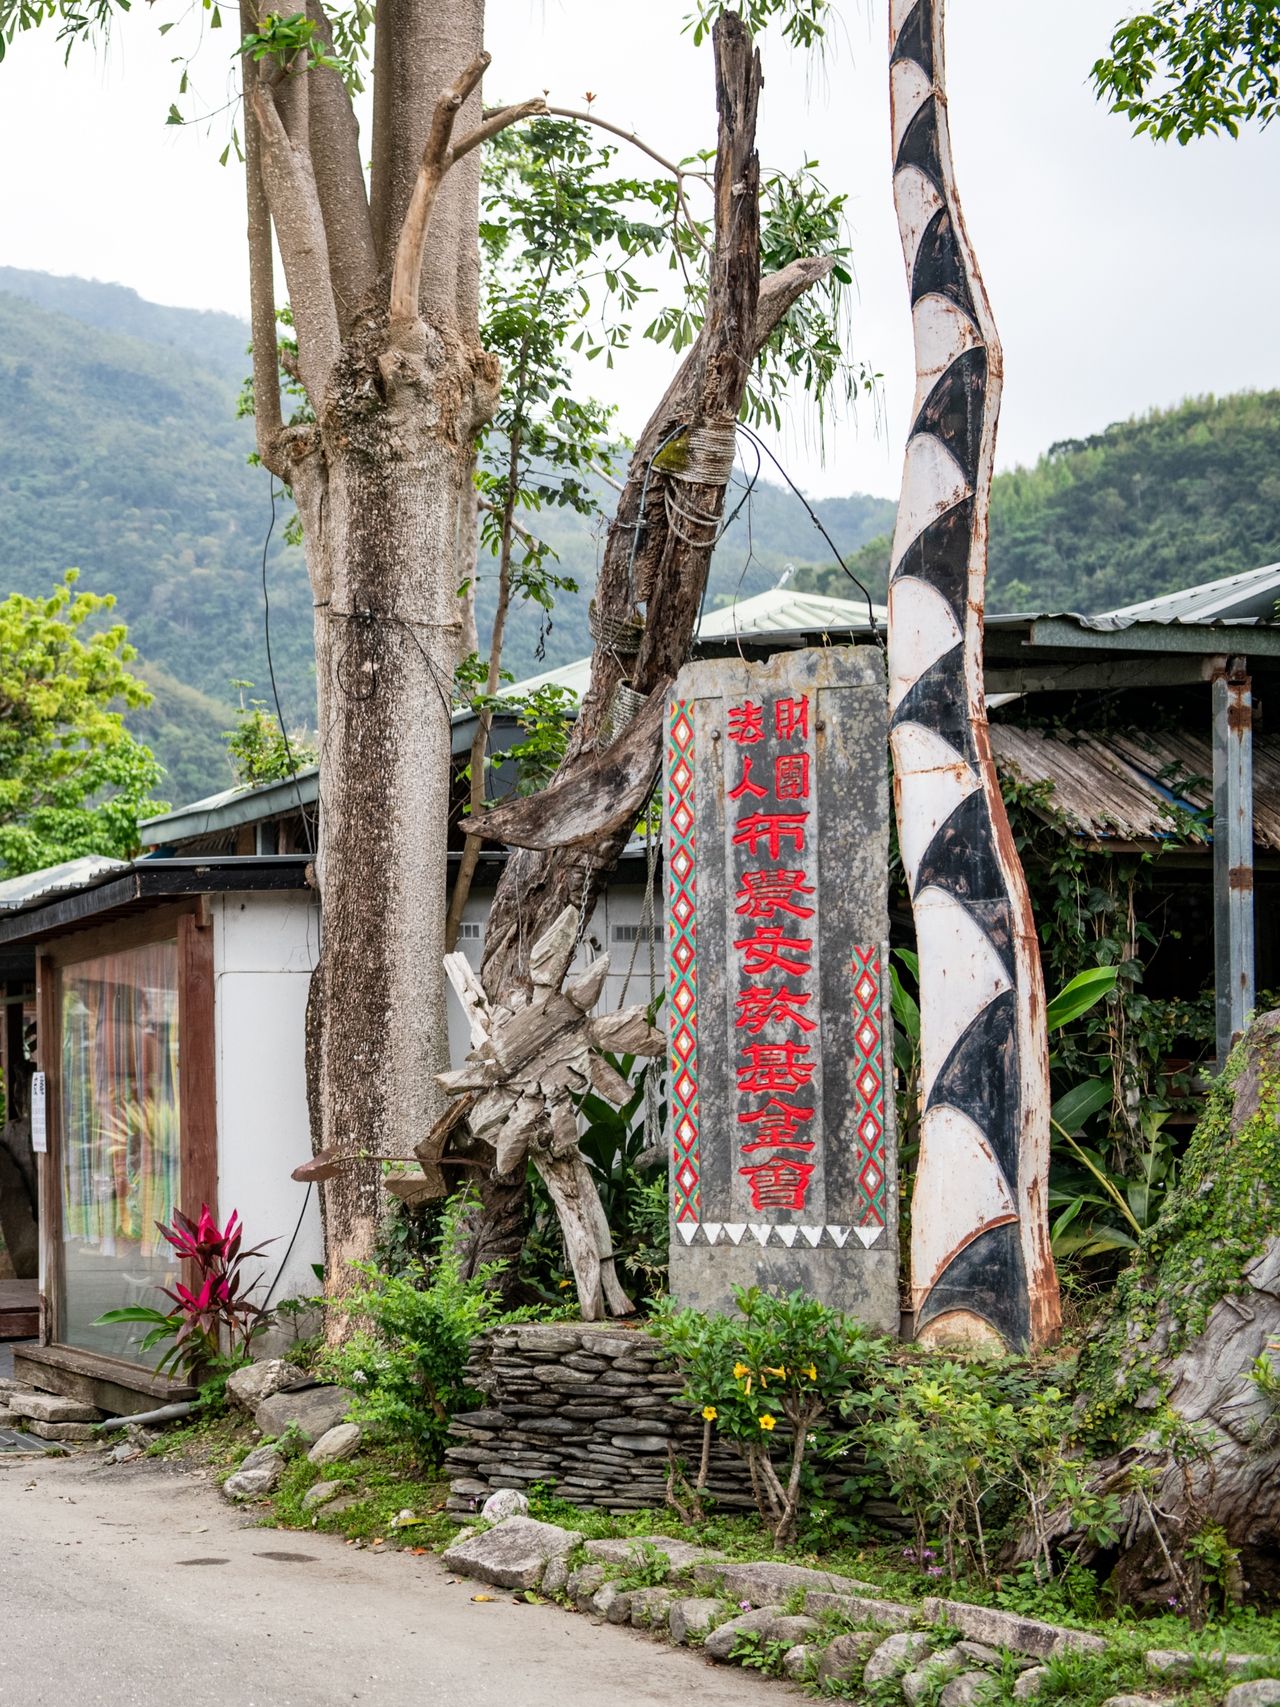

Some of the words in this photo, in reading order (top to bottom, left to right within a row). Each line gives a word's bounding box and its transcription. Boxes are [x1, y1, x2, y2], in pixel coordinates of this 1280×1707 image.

[727, 700, 769, 801] 法人
[775, 694, 810, 800] 財團
[732, 811, 818, 1211] 布農文教基金會
